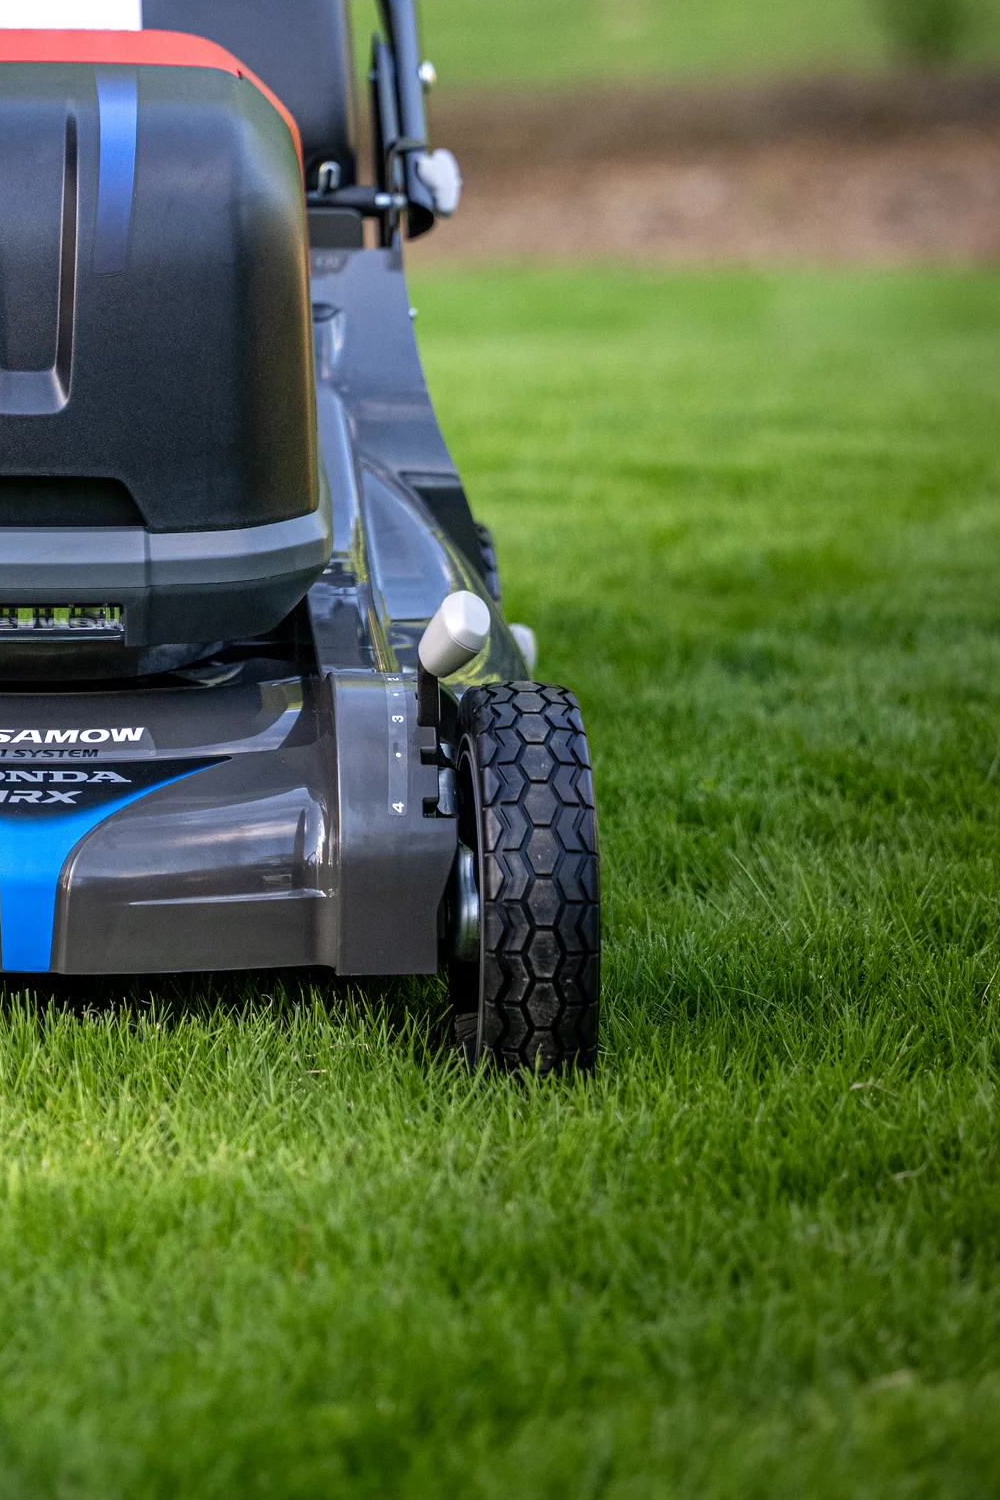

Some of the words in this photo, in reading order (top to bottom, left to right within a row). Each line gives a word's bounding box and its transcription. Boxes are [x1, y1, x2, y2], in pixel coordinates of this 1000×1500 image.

[391, 715, 404, 723] 3
[12, 748, 99, 758] SYSTEM
[391, 801, 405, 814] 4
